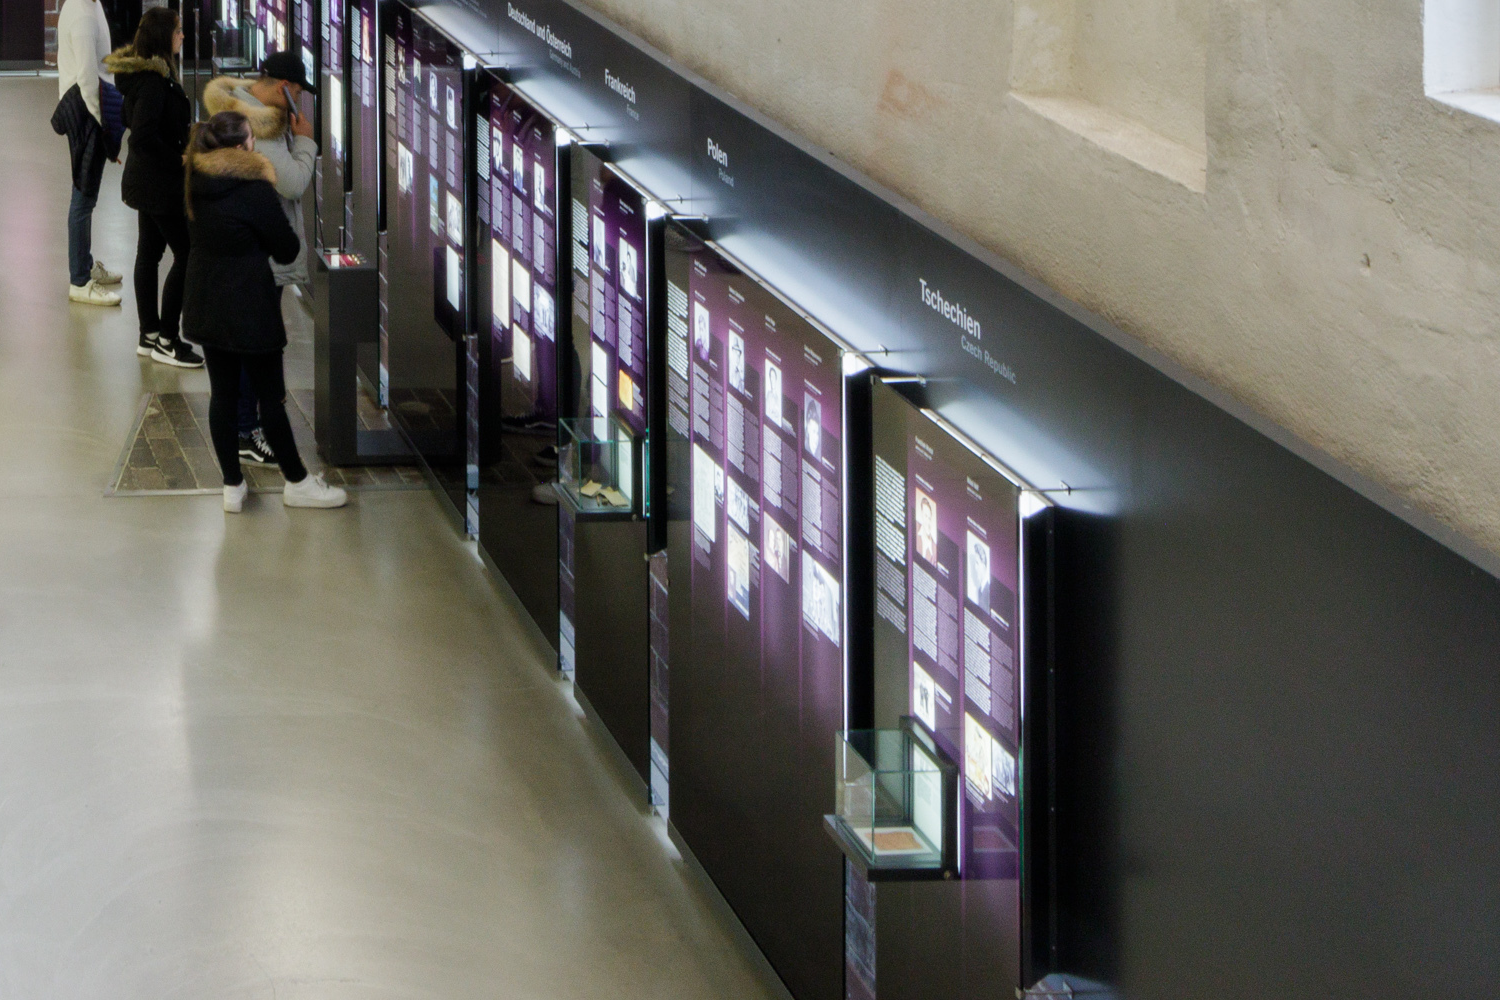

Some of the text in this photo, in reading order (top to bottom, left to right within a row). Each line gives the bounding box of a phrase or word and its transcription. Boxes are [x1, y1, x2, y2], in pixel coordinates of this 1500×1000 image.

[507, 1, 572, 59] Deutschland und Österreich
[604, 68, 636, 104] Frankreich
[626, 103, 639, 120] France
[707, 137, 728, 167] Polen
[718, 167, 734, 187] Poland
[919, 277, 981, 340] Tschechien
[961, 335, 1016, 384] Czech Republic
